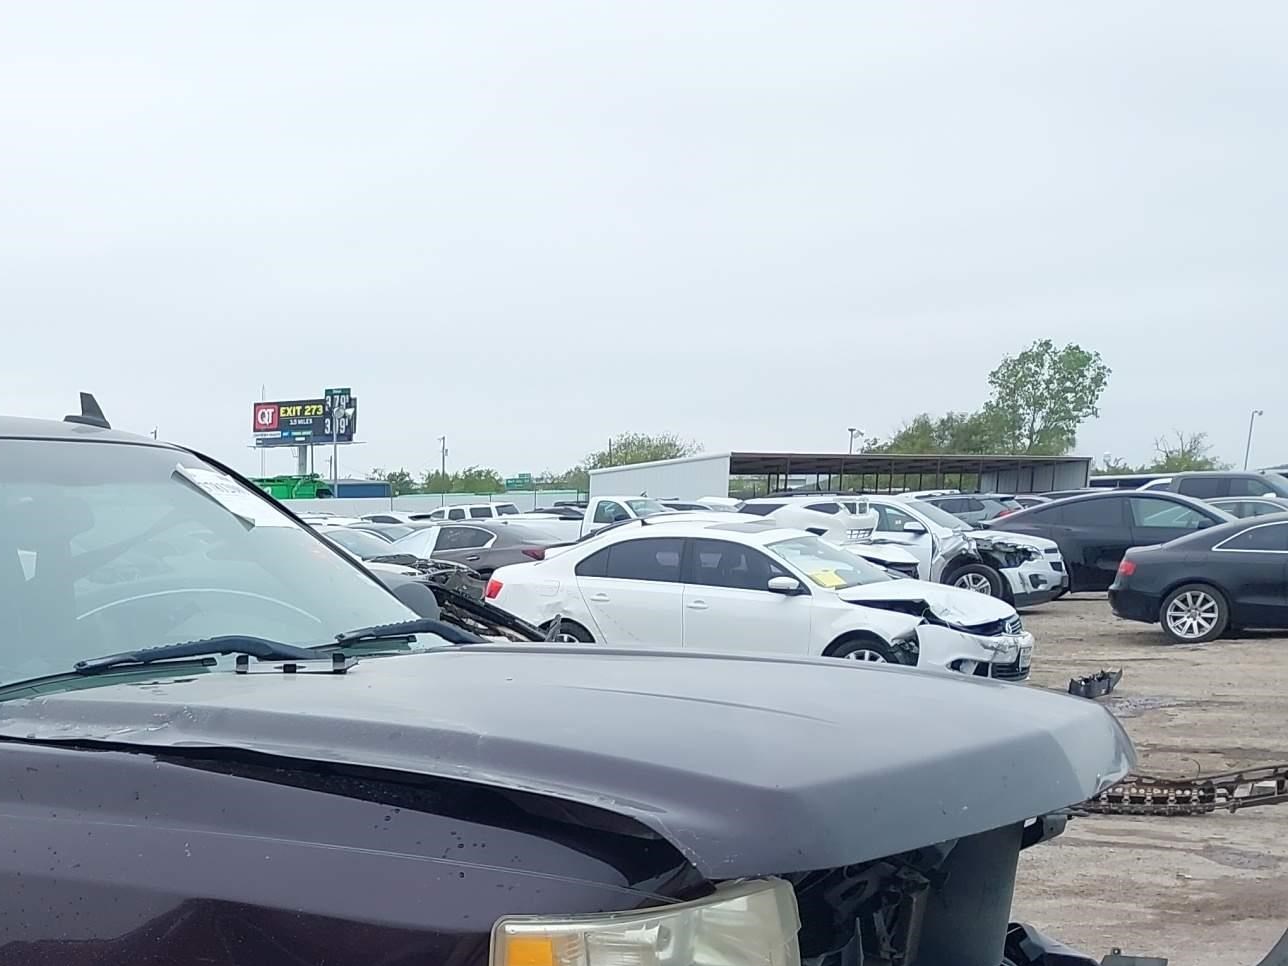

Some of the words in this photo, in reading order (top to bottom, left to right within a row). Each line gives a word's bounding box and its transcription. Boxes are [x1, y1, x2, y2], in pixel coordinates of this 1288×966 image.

[257, 408, 275, 426] QT
[280, 406, 302, 417] EXIT
[304, 404, 324, 416] 273
